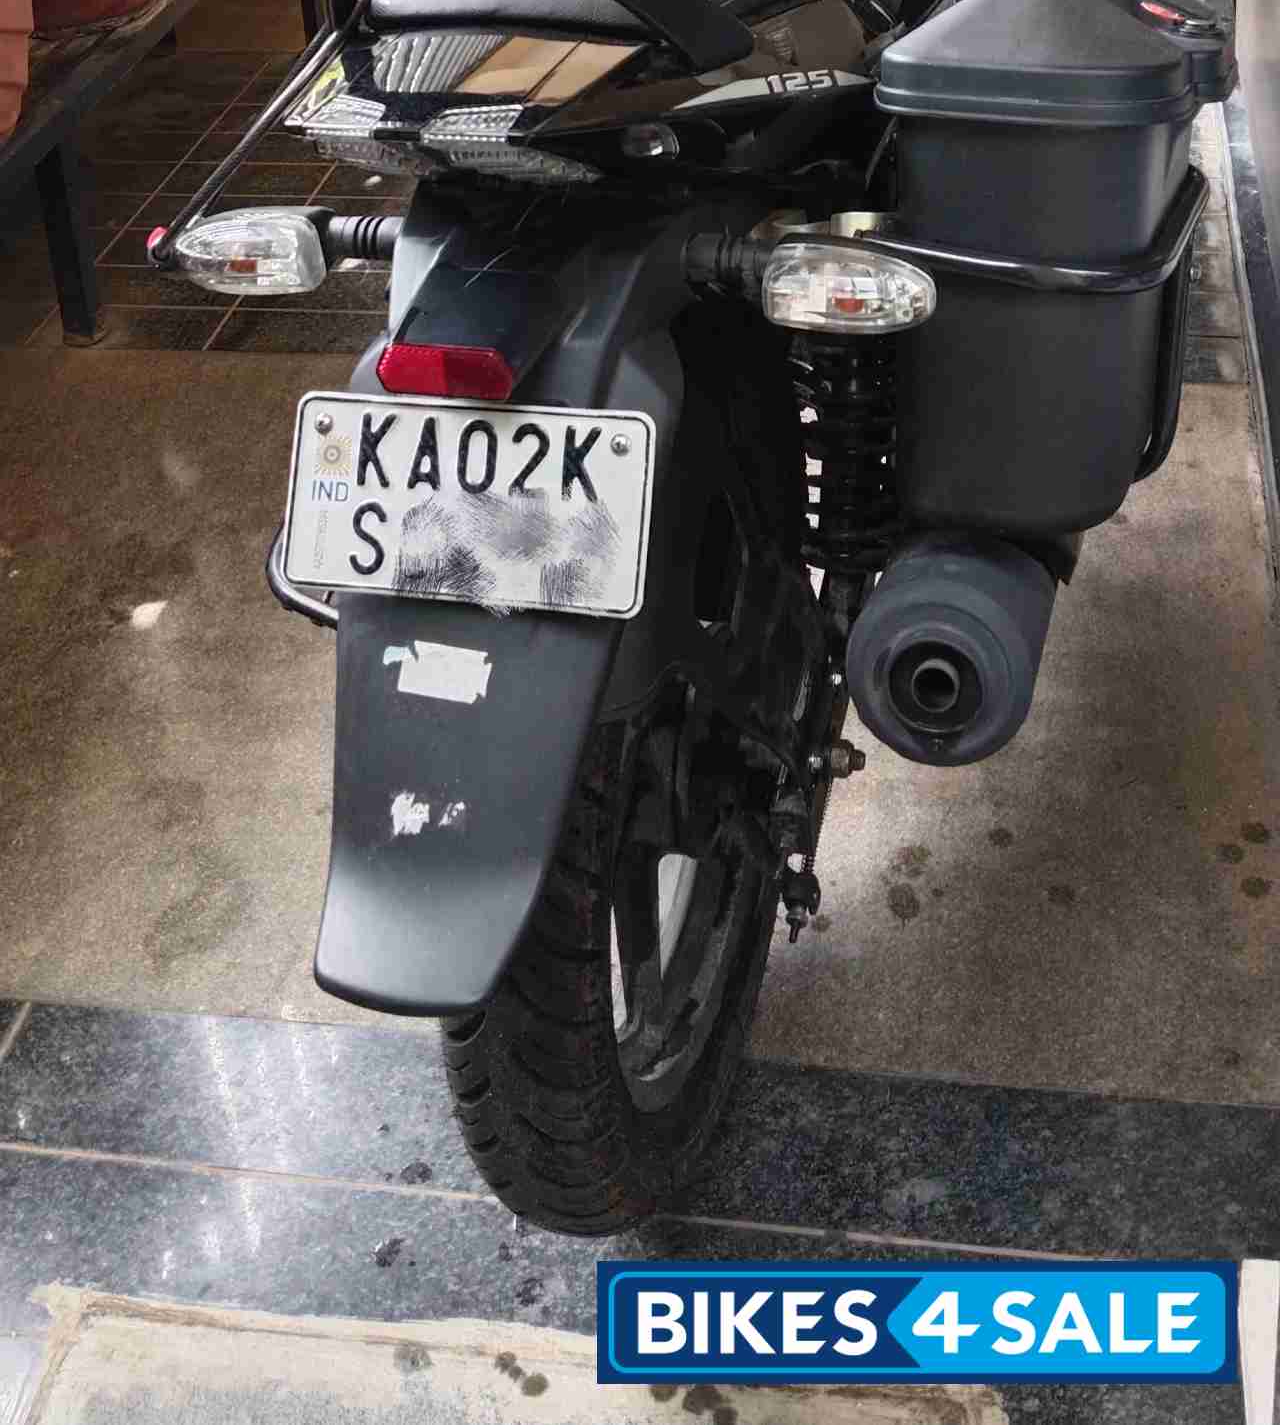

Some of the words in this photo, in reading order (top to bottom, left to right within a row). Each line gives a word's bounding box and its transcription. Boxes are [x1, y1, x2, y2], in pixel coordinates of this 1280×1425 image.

[766, 69, 832, 93] 125
[357, 413, 601, 503] KA02K
[311, 479, 349, 503] IND
